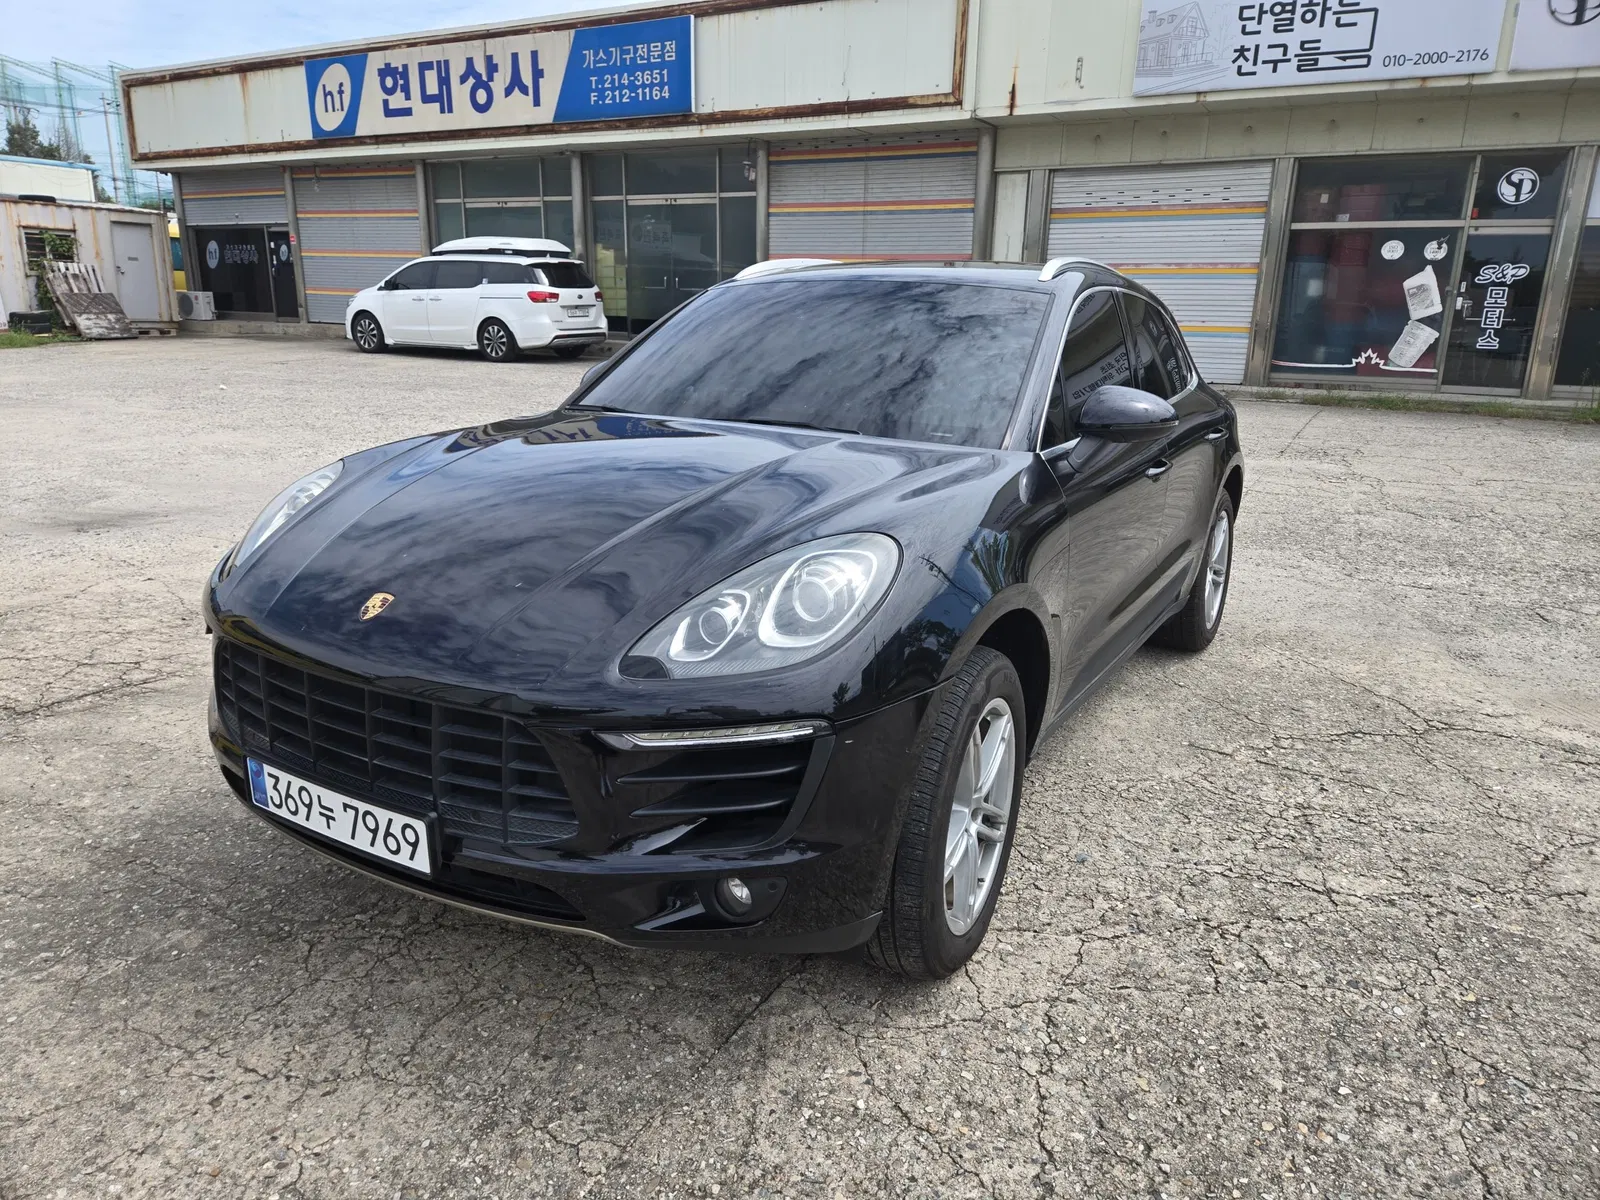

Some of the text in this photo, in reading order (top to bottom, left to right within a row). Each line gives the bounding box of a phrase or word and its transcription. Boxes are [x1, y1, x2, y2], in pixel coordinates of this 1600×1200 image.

[1238, 0, 1378, 35] 단열하는
[582, 39, 677, 70] 가스기구전문점
[1231, 39, 1371, 76] 친구들
[1382, 48, 1490, 68] 010-2000-2176
[377, 49, 545, 118] 현대상사
[590, 68, 670, 89] T.214-3651
[590, 86, 670, 105] F.212-1164
[1475, 263, 1530, 284] S&P
[1476, 287, 1508, 349] 모터스
[267, 772, 420, 861] 369누 7969
